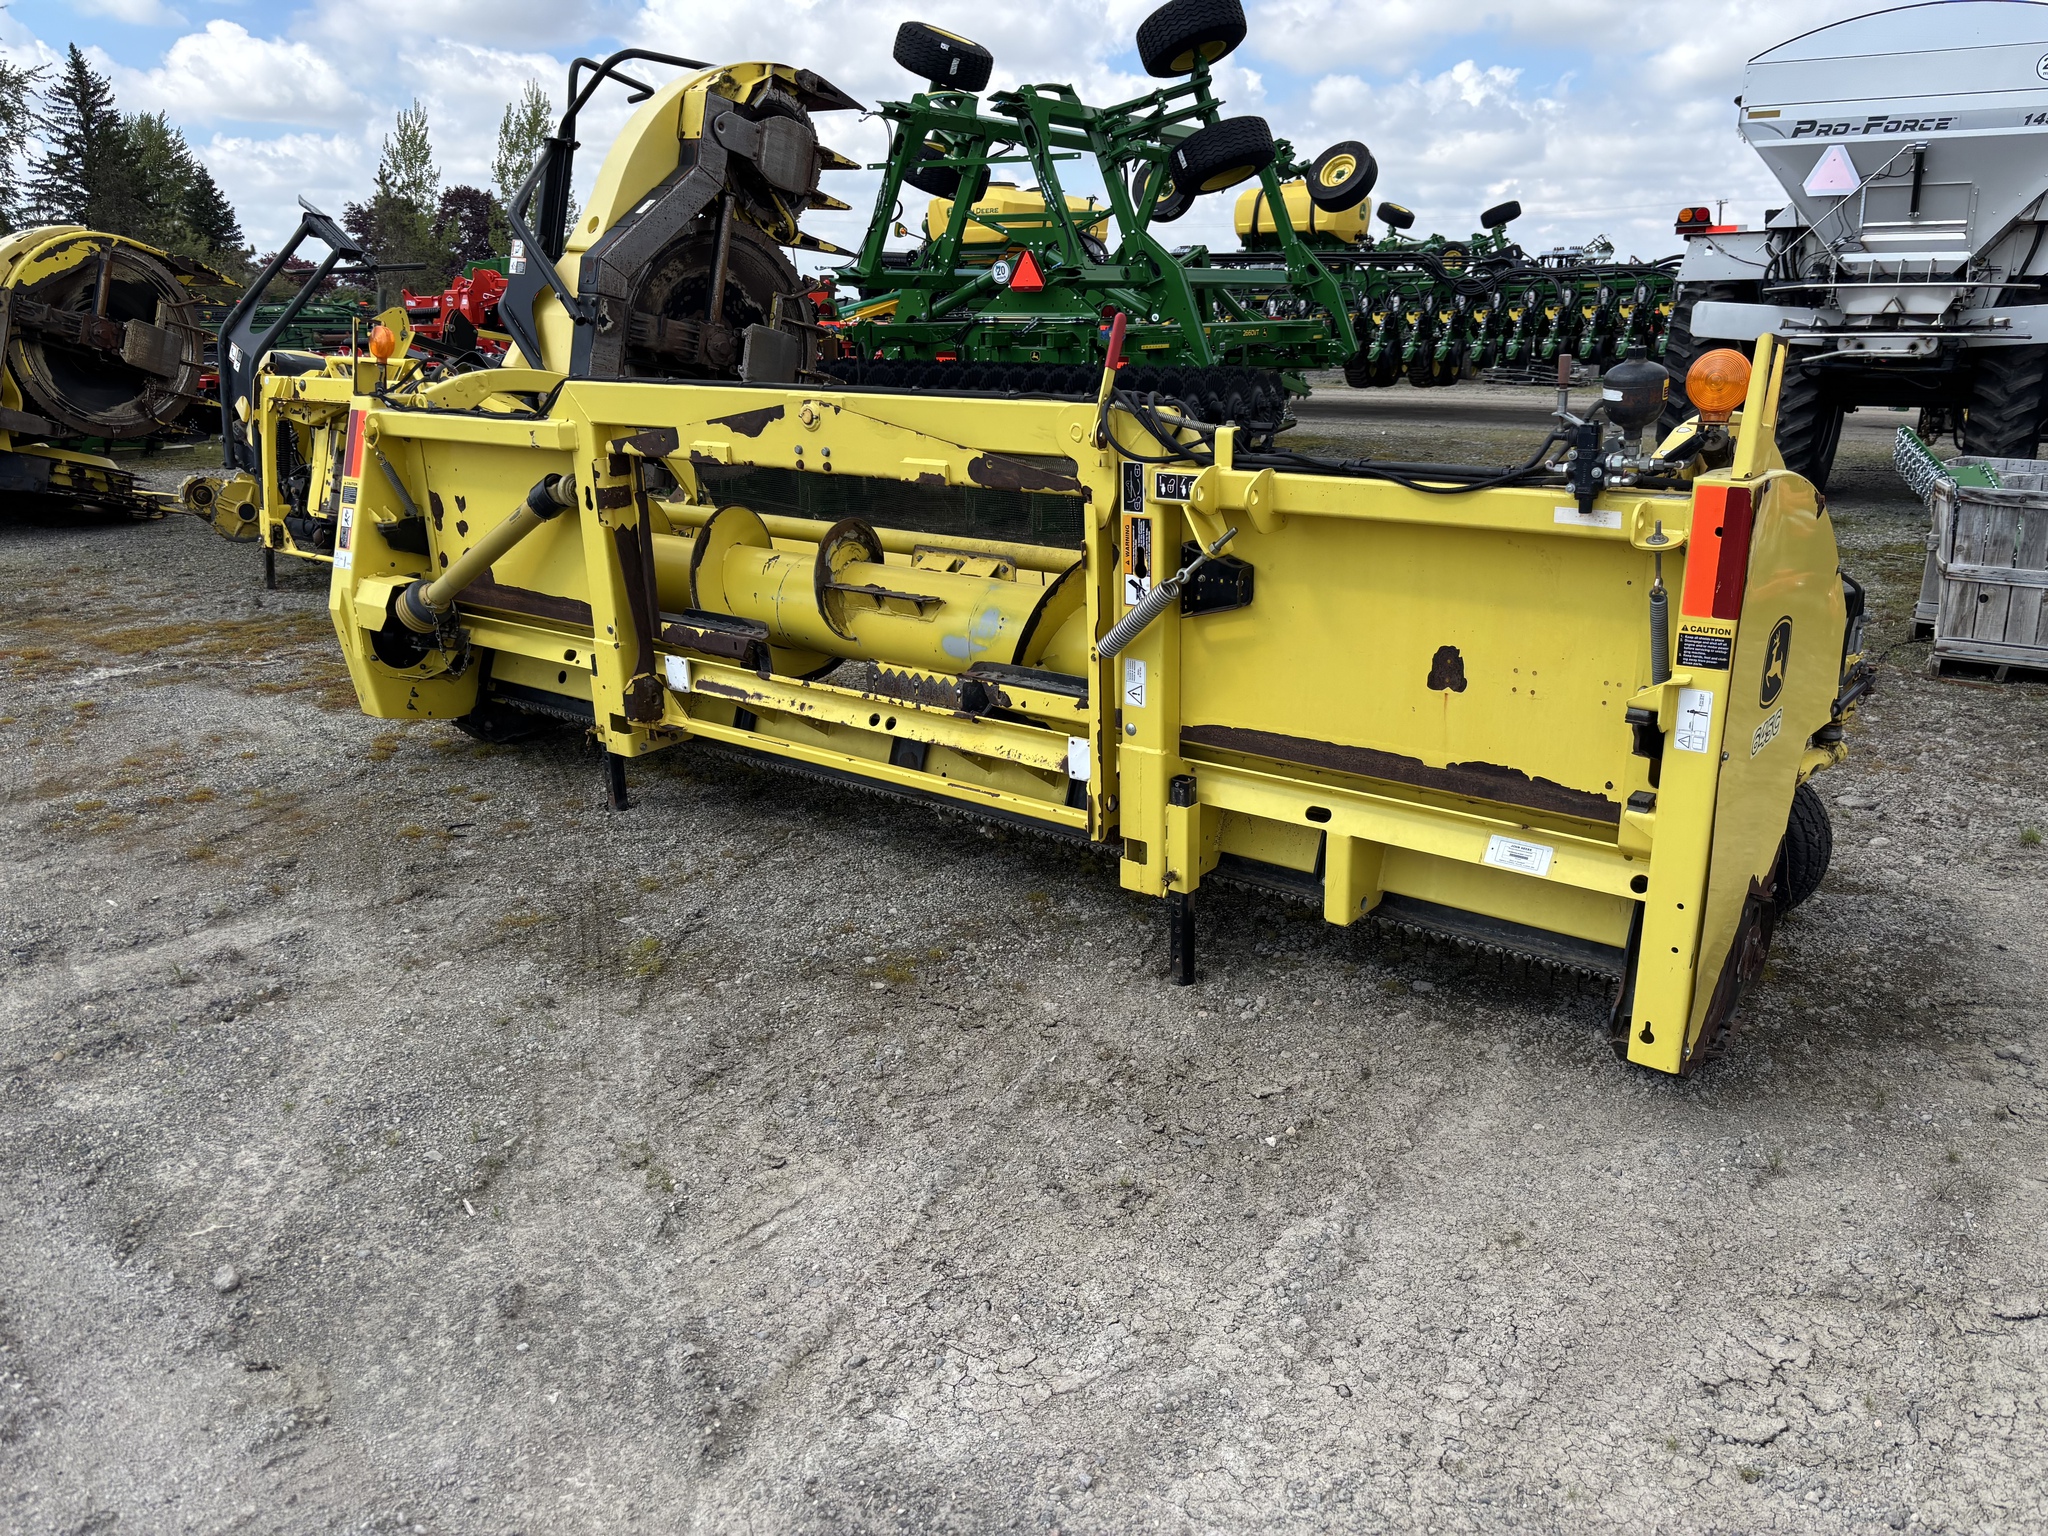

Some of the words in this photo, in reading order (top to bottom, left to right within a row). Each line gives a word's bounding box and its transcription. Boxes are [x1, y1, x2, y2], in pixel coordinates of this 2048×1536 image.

[1791, 116, 1952, 138] PRO-FORCE
[995, 265, 1005, 276] 20
[1690, 626, 1731, 635] CAUTION
